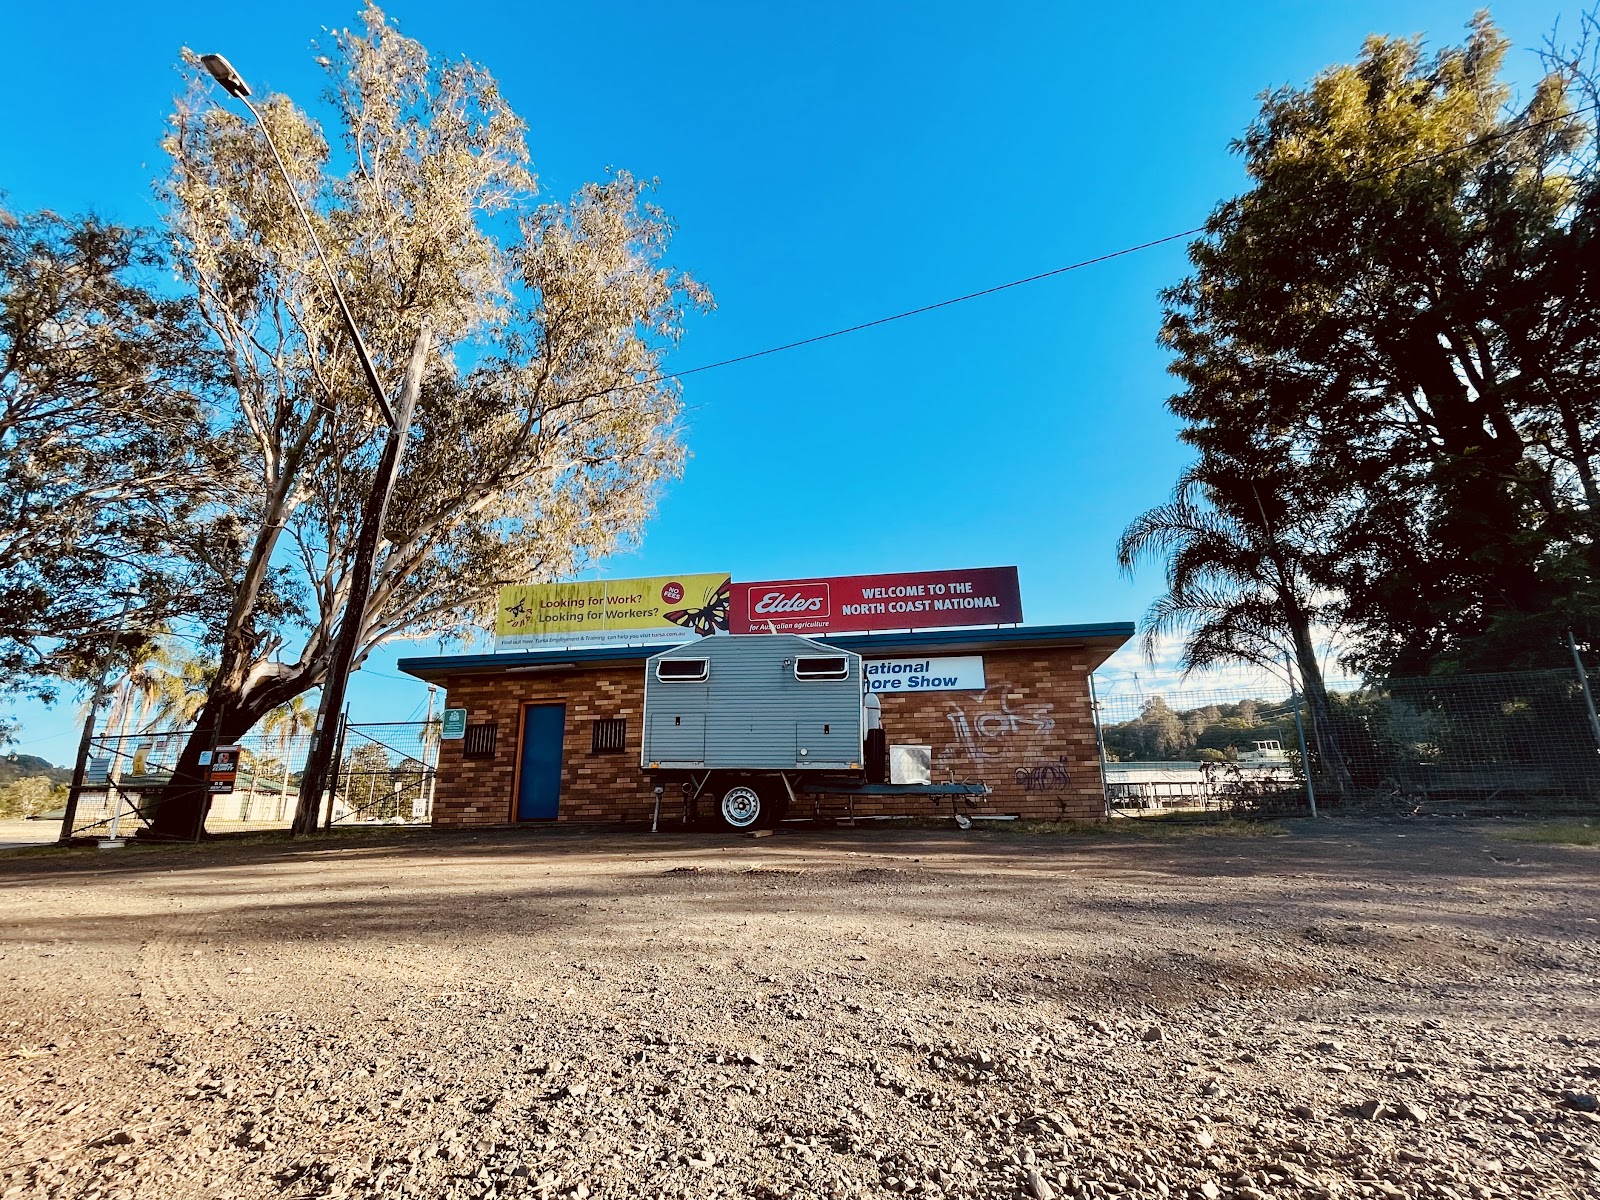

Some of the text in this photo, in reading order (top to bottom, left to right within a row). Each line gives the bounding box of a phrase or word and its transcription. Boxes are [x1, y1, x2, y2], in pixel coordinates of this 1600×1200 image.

[664, 591, 681, 600] FEES
[862, 582, 973, 599] WELCOME TO THE
[540, 594, 643, 610] Looking for Work?
[754, 592, 824, 614] Elders
[842, 596, 1001, 616] NORTH COAST NATIONAL
[539, 608, 659, 623] Looking for Workers?
[749, 620, 830, 632] for Ausralian agriculture
[907, 675, 958, 688] Show
